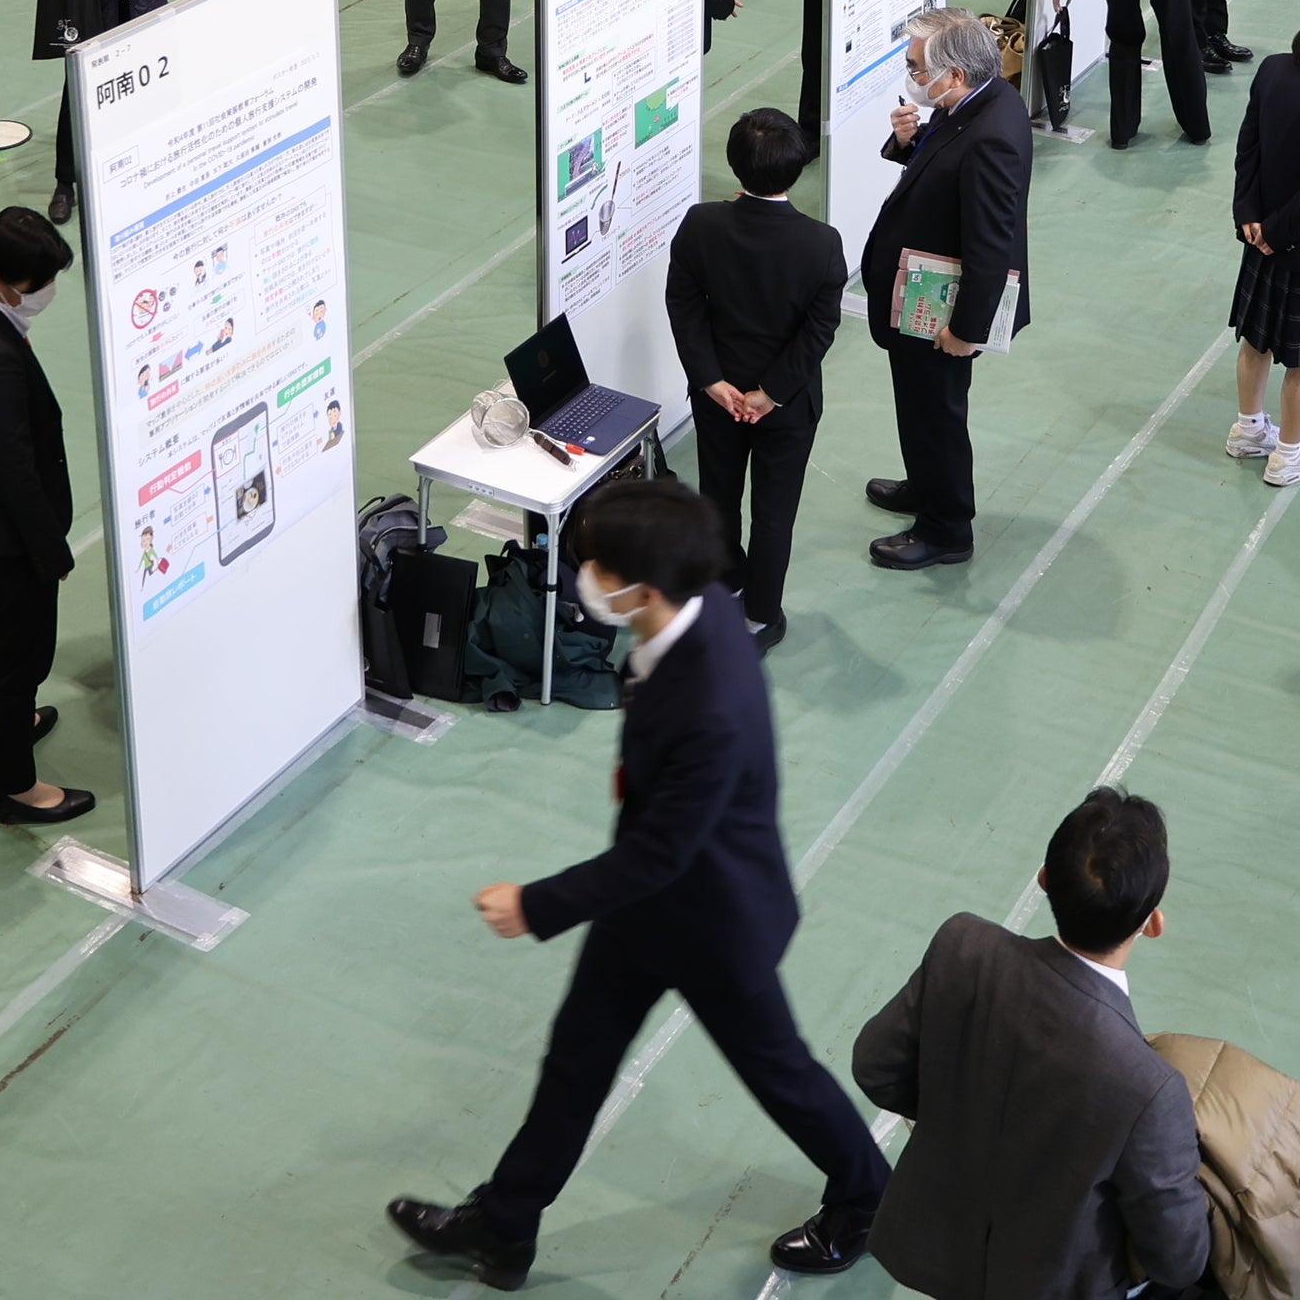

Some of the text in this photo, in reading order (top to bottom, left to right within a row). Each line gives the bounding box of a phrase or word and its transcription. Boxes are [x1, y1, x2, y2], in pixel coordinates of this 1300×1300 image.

[95, 52, 170, 111] 阿南０２
[119, 75, 317, 189] コロナ禍における旅行活性化のための個人旅行支援システムの開発
[108, 153, 133, 175] 阿南02
[137, 431, 180, 469] システム概要
[133, 507, 155, 531] 旅行者
